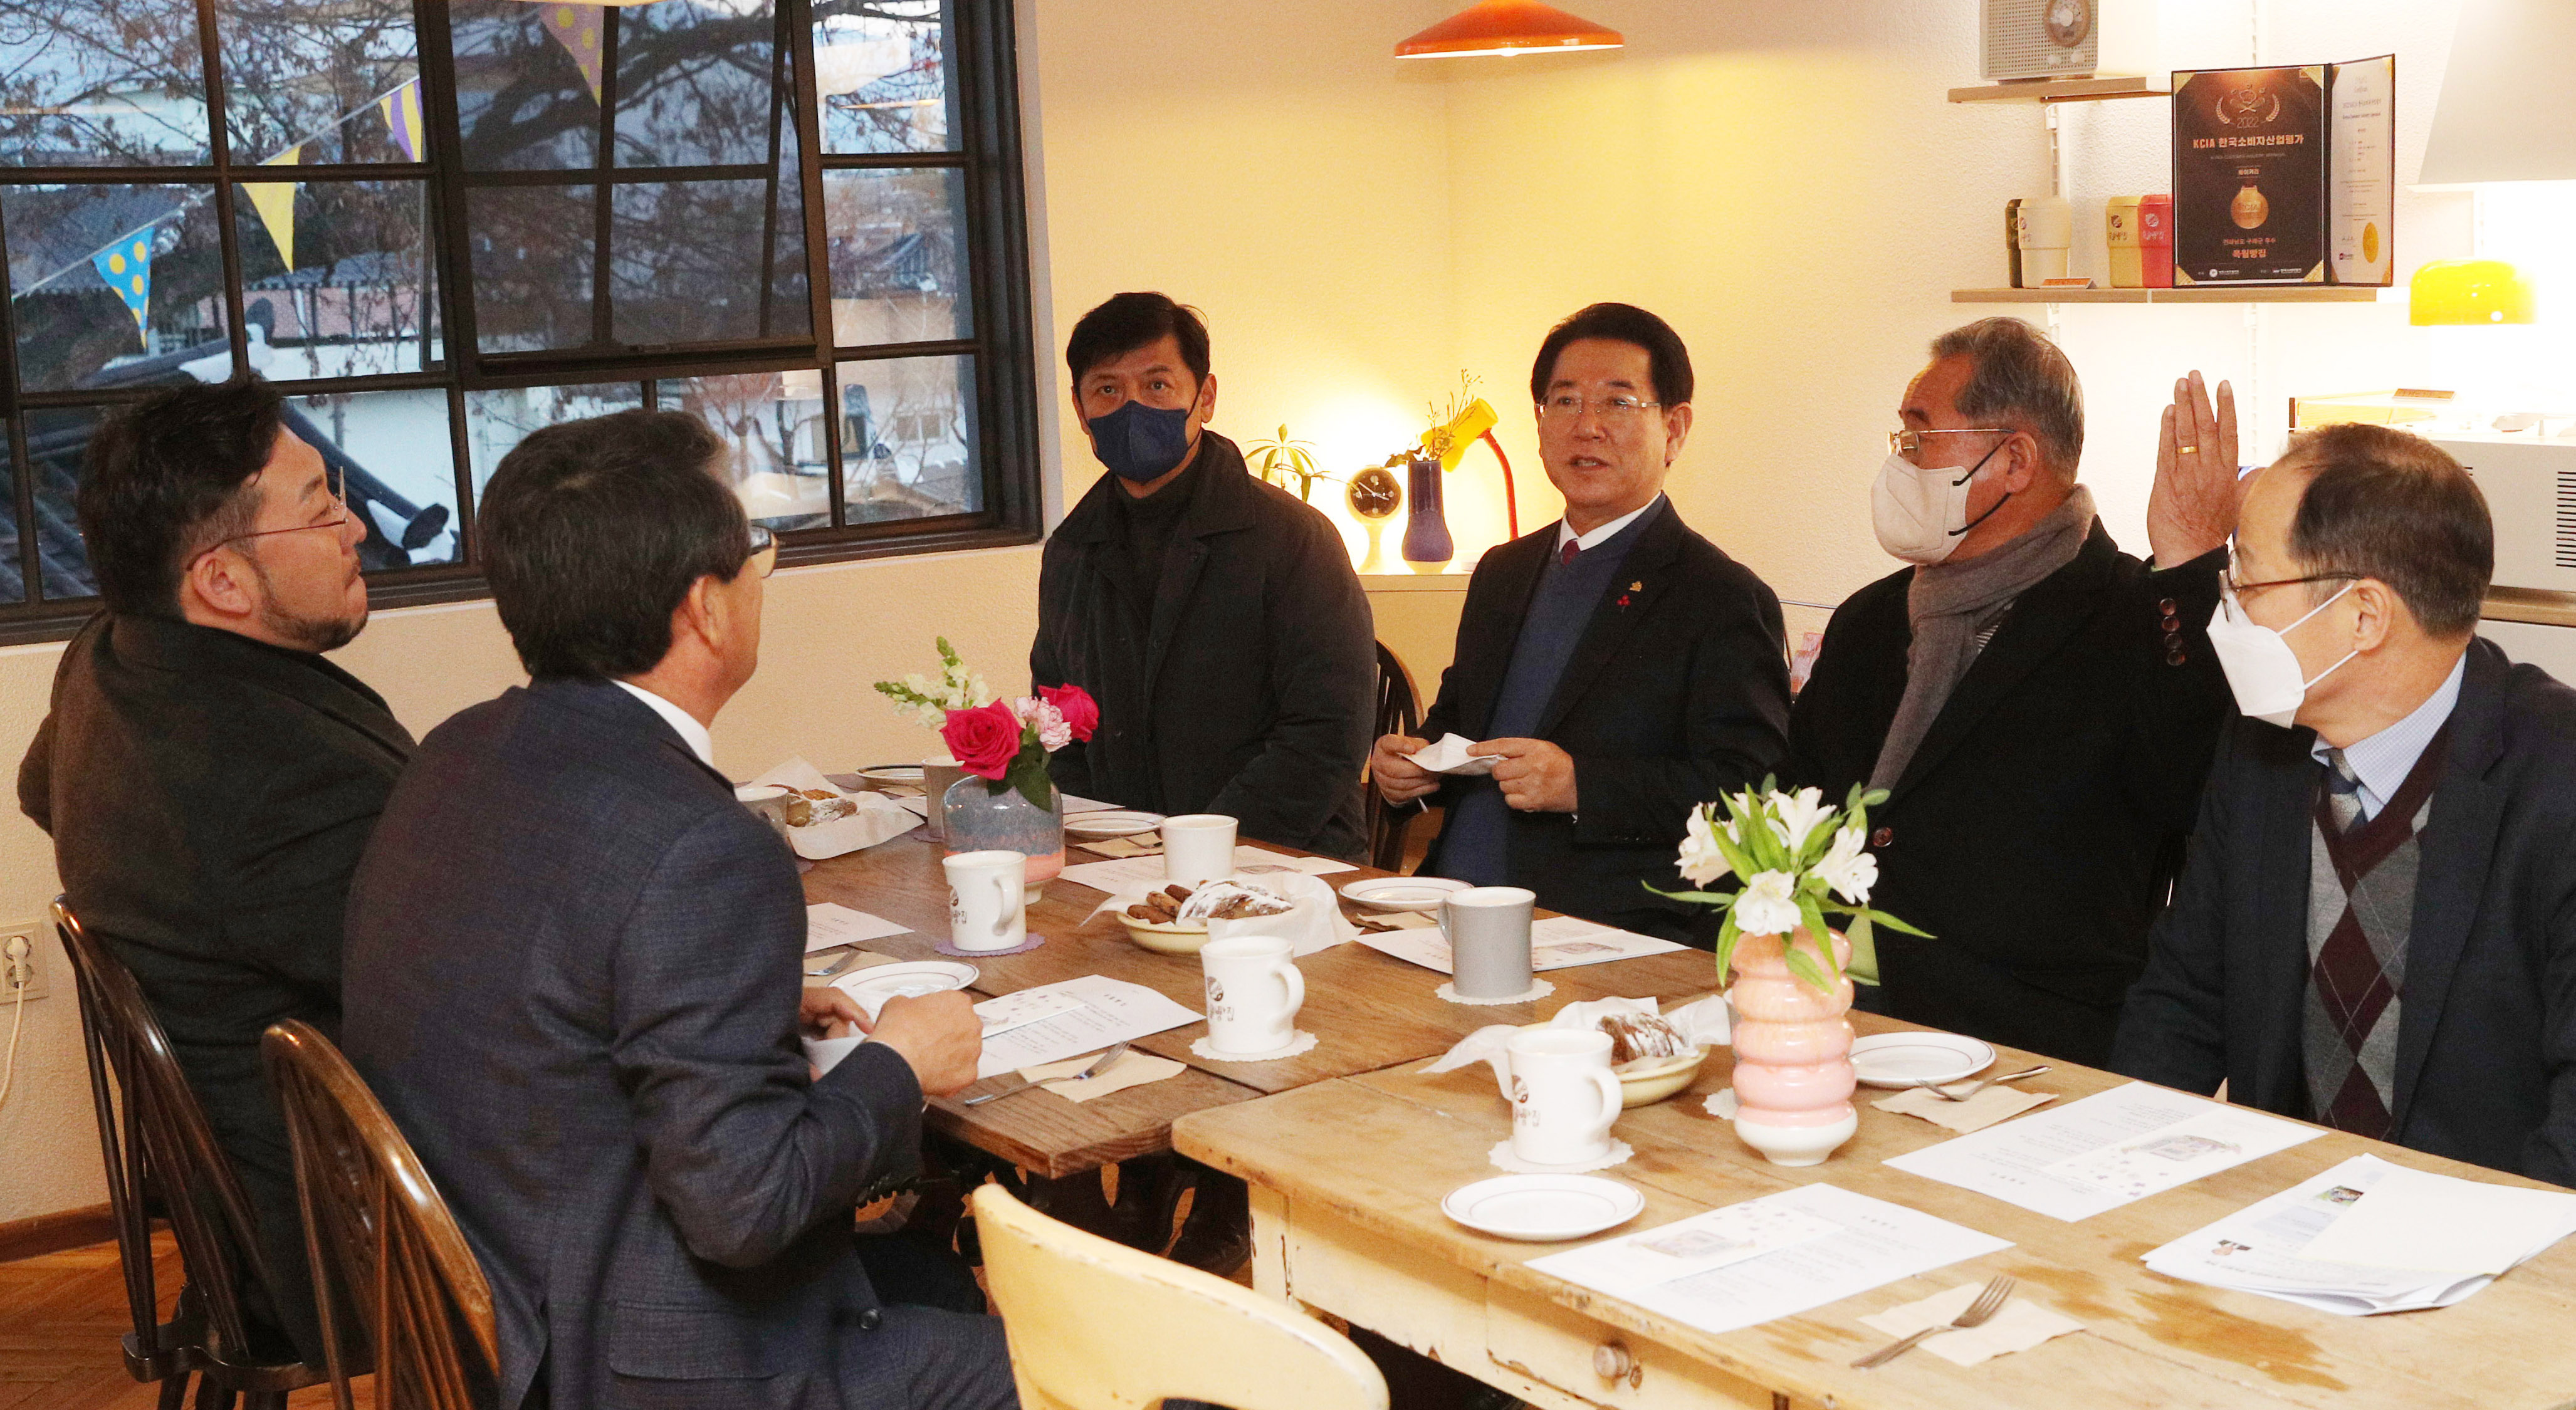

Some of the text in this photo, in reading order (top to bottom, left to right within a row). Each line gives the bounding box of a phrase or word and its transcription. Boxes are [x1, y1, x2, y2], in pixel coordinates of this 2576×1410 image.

[2237, 117, 2259, 128] 2022
[2193, 134, 2304, 149] KCIA 한국소비자산업평가
